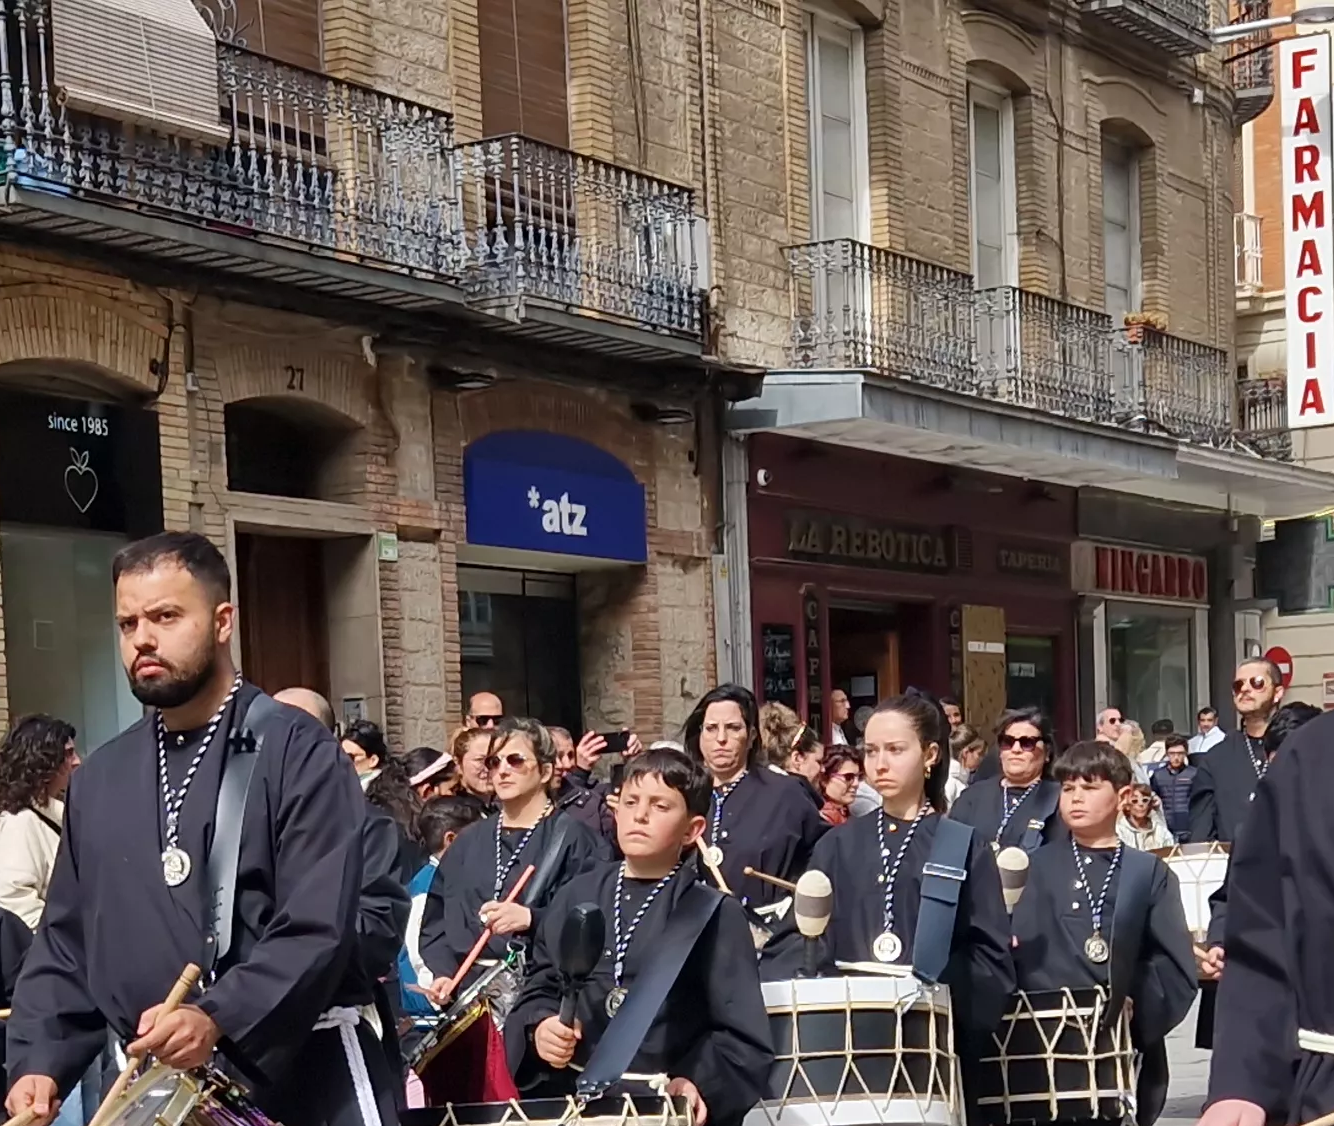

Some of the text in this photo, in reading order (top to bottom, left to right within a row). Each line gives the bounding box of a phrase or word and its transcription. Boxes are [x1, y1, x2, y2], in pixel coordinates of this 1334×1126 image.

[1292, 48, 1325, 416] FARMACIA
[284, 365, 304, 391] 27
[48, 411, 109, 436] since 1985
[830, 524, 948, 567] REBOTICA
